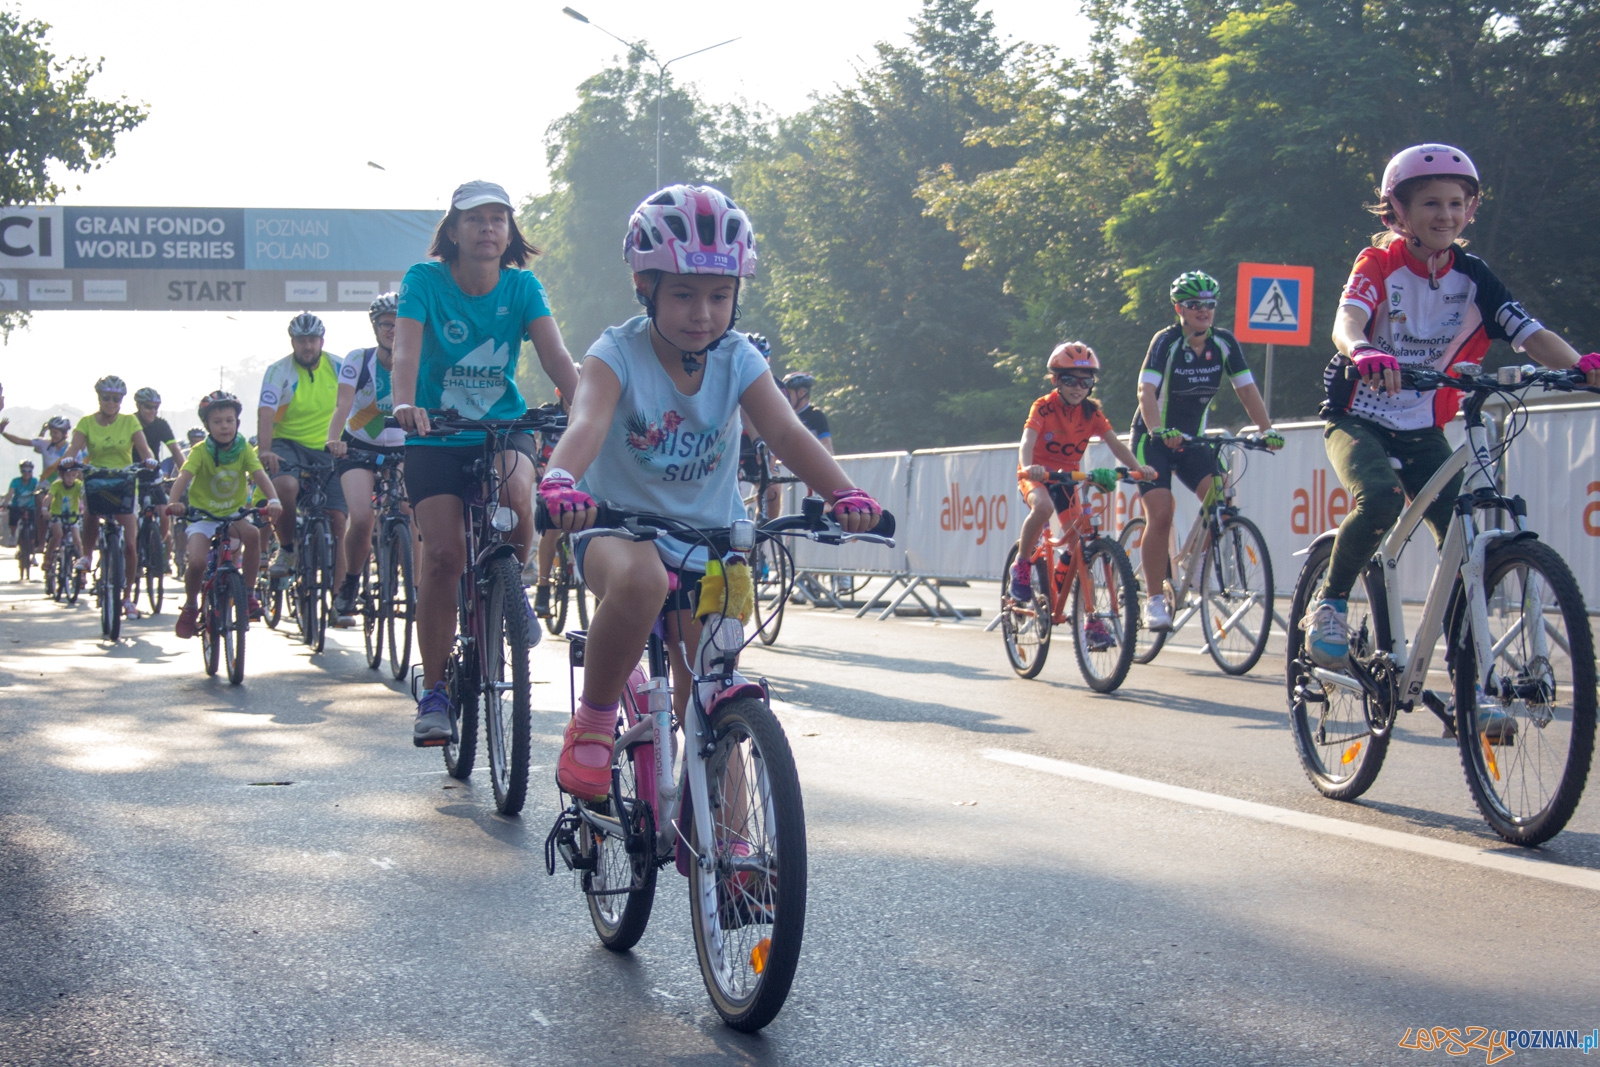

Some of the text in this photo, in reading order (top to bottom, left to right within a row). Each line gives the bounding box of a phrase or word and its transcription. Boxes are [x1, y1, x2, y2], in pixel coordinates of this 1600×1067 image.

[75, 216, 225, 236] GRAN FONDO
[256, 219, 329, 237] POZNAN
[75, 240, 235, 260] WORLD SERIES
[256, 241, 330, 260] POLAND
[167, 280, 247, 302] START
[451, 365, 502, 379] BIKE
[1174, 367, 1195, 375] AUTO
[662, 455, 714, 482] SUN
[940, 482, 1009, 546] allegro
